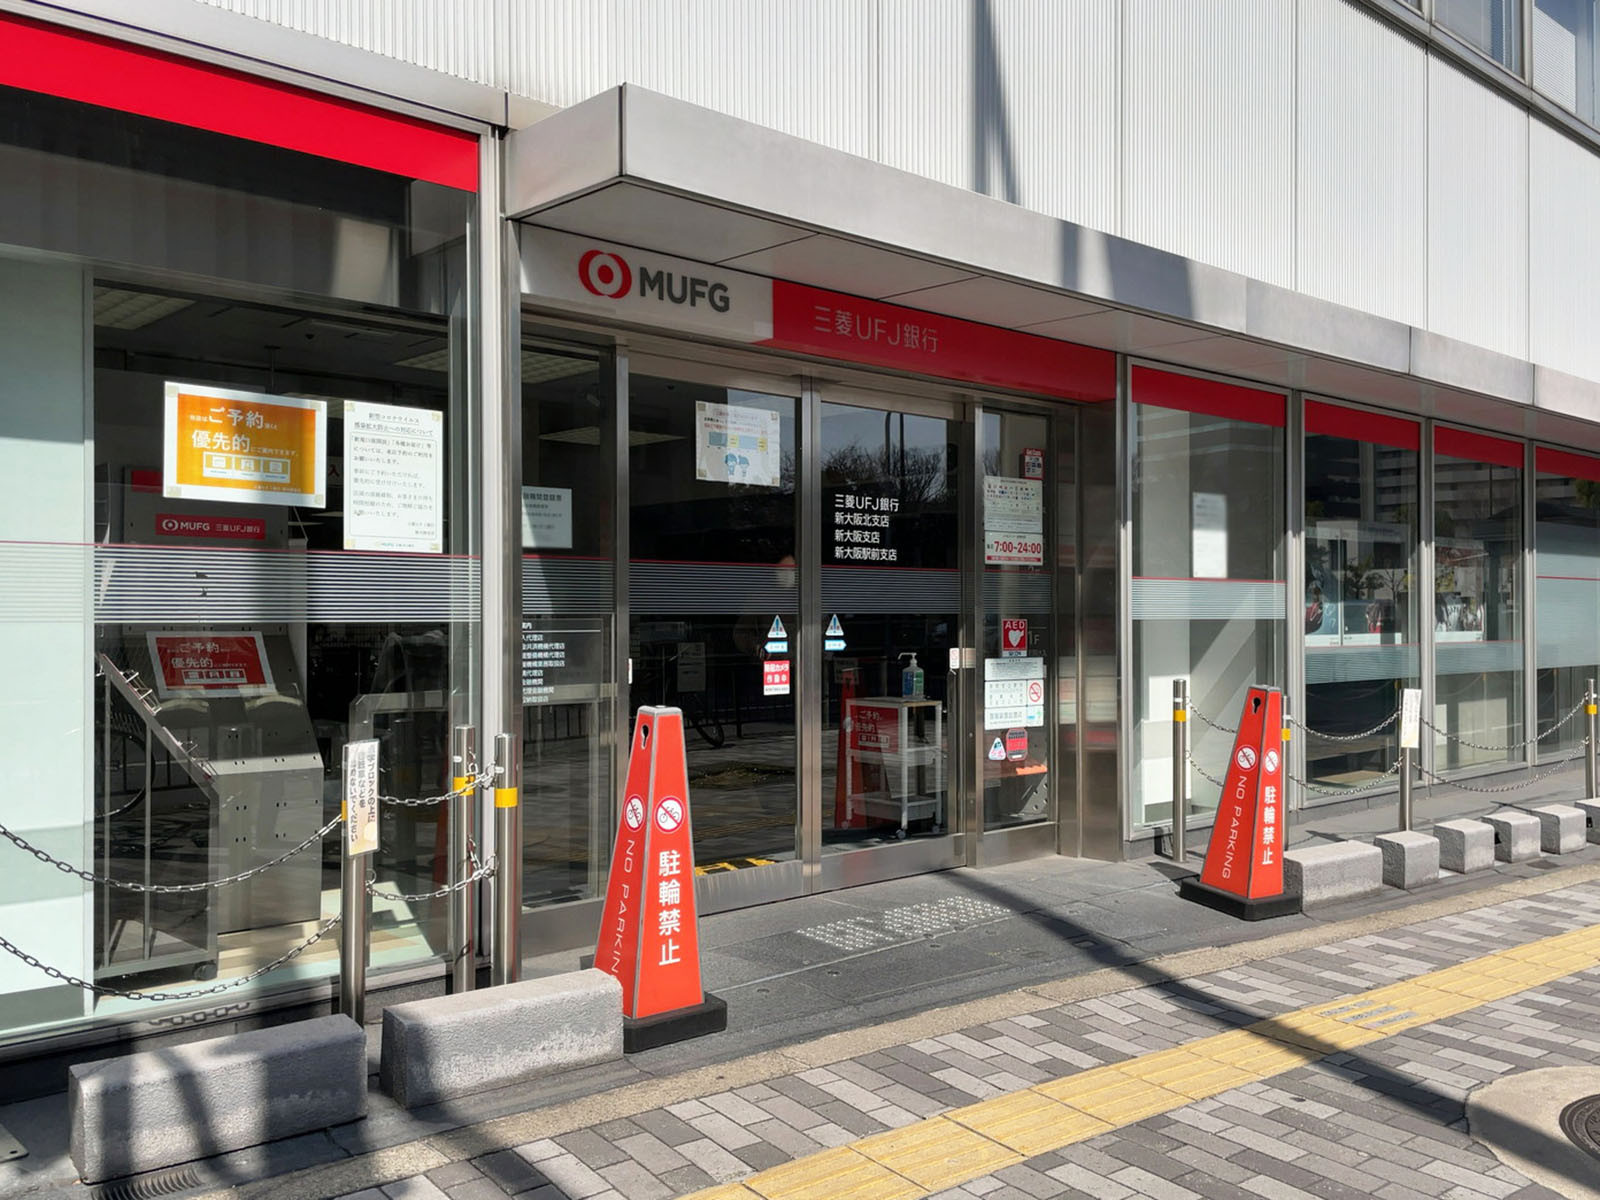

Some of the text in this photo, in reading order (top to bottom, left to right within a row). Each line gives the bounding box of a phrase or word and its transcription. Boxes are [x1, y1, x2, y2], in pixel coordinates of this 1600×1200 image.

[640, 266, 730, 313] MUFG
[814, 305, 938, 353] 三菱UFJ銀行
[209, 406, 264, 429] ご予約
[192, 429, 250, 452] 優先的
[835, 493, 899, 512] 三菱UFJ銀行
[180, 521, 210, 531] MUFG
[215, 523, 260, 534] 三菱UFJ銀行
[834, 511, 889, 527] 新大阪北支店
[834, 529, 880, 544] 新大阪支店
[834, 546, 897, 561] 新大阪駅前支店
[1005, 621, 1025, 629] AED
[172, 657, 213, 668] 優先的
[1222, 775, 1247, 880] NO PARKING
[1262, 786, 1276, 865] 駐輪禁止
[611, 839, 635, 973] NO PARKIN
[658, 850, 680, 966] 駐輪禁止
